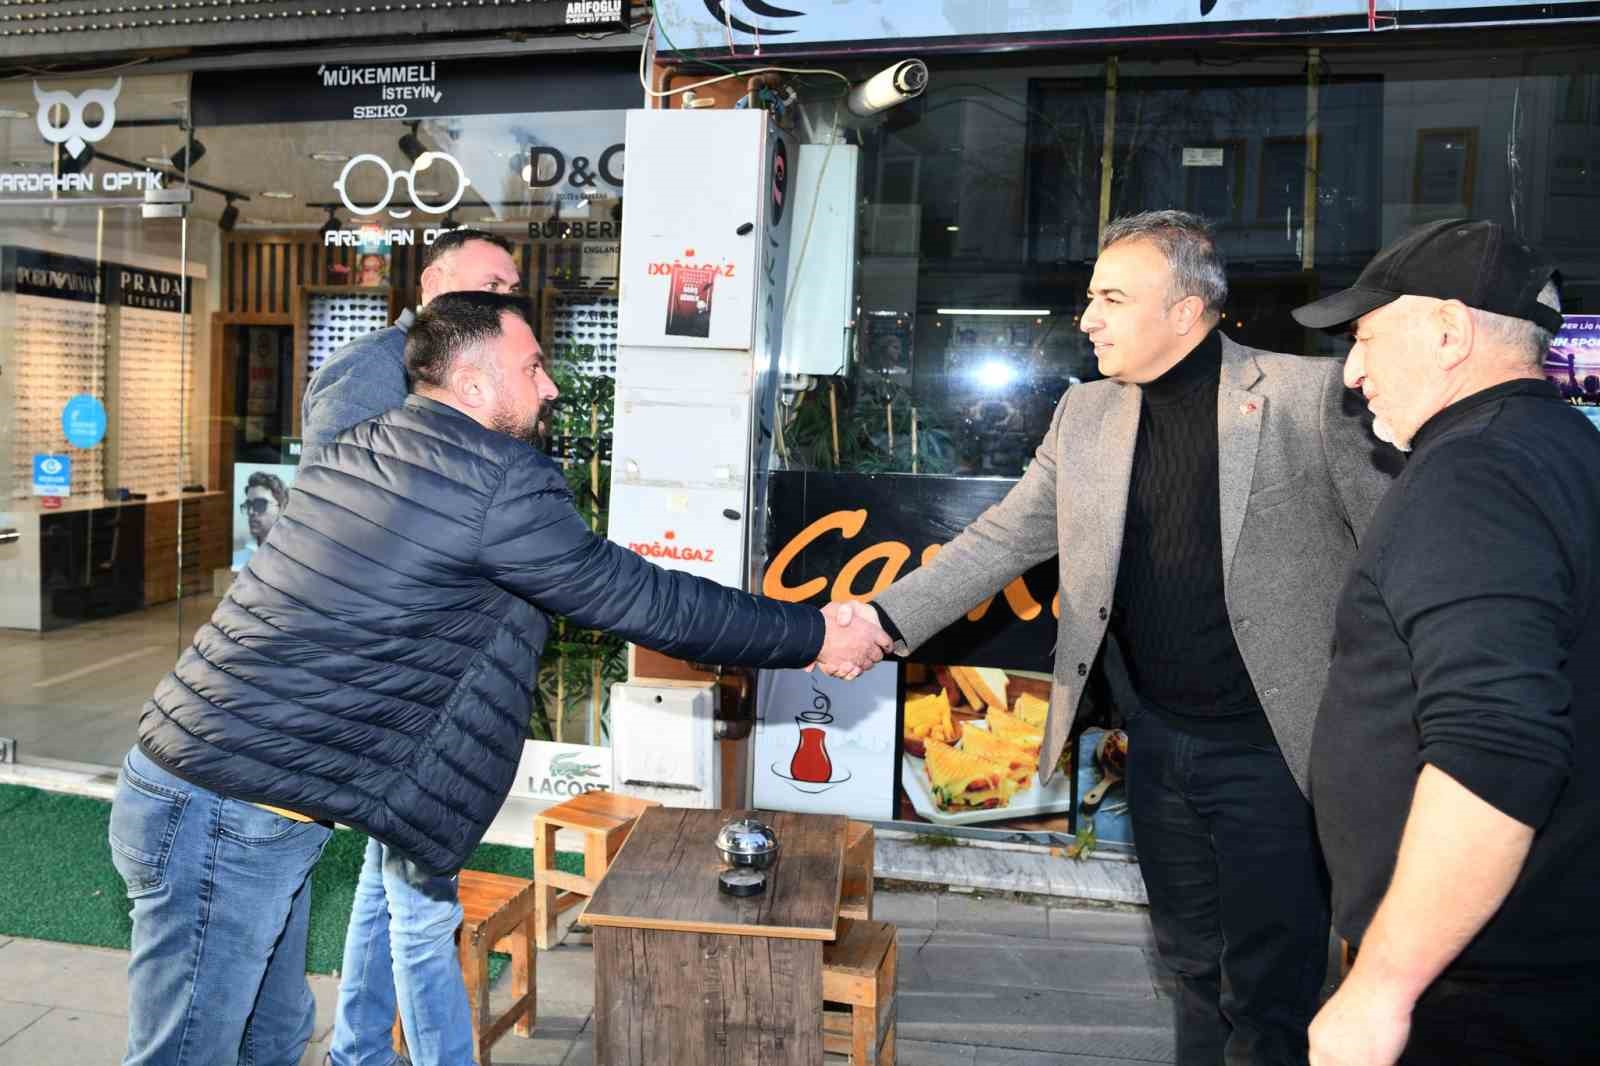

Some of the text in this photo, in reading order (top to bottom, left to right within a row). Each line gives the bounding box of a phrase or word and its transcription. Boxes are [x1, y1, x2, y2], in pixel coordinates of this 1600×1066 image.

[353, 104, 408, 118] SEIKO
[0, 168, 163, 191] ARDAHAN OPTİK
[120, 272, 186, 297] PRADA
